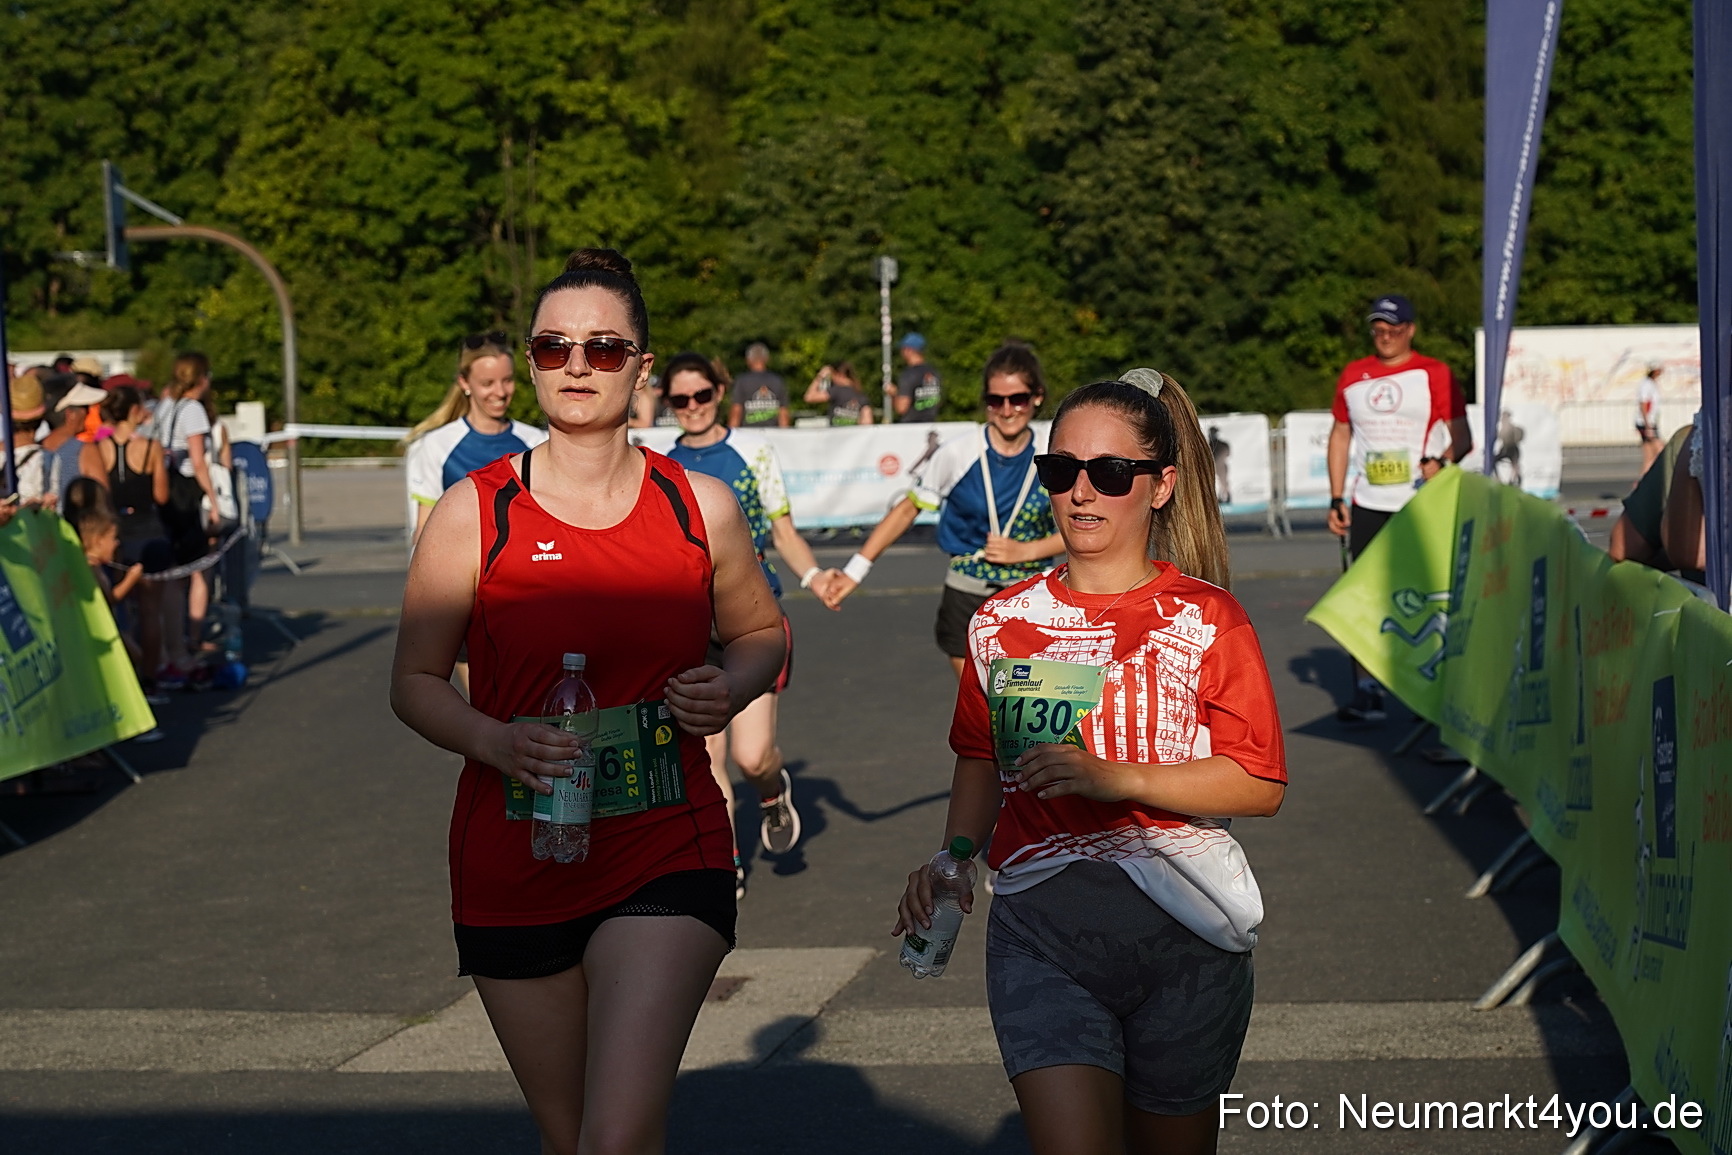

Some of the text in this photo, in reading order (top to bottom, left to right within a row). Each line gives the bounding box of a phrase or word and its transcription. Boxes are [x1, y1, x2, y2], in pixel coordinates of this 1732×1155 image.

[531, 552, 562, 561] erima
[1050, 617, 1083, 628] 10.54
[1006, 679, 1043, 688] Firmenlauf
[998, 697, 1072, 736] 1130
[623, 748, 640, 798] 2022
